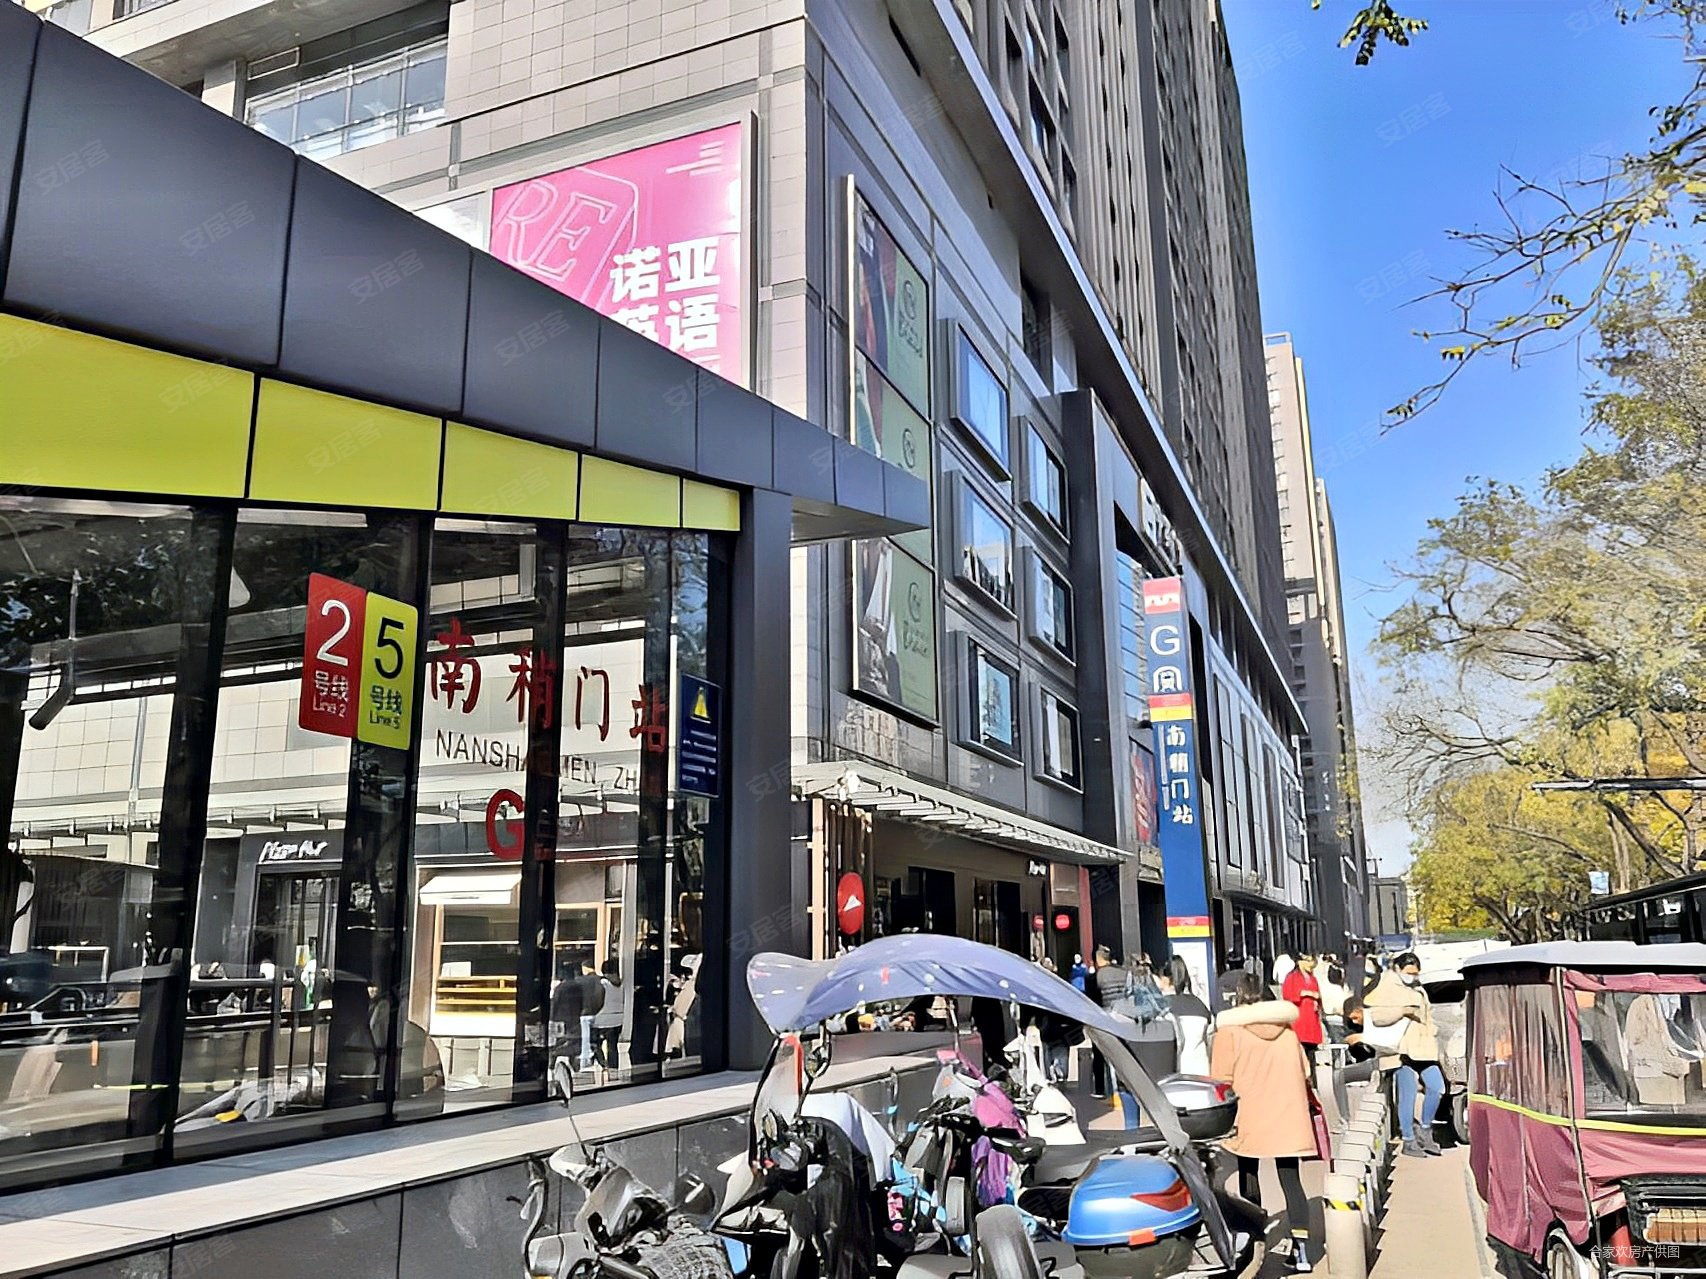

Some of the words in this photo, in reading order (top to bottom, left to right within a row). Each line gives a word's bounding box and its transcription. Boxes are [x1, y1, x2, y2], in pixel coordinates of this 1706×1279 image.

[609, 237, 720, 303] 诺亚
[315, 599, 351, 667] 2
[374, 616, 404, 680] 5
[1150, 625, 1180, 656] G
